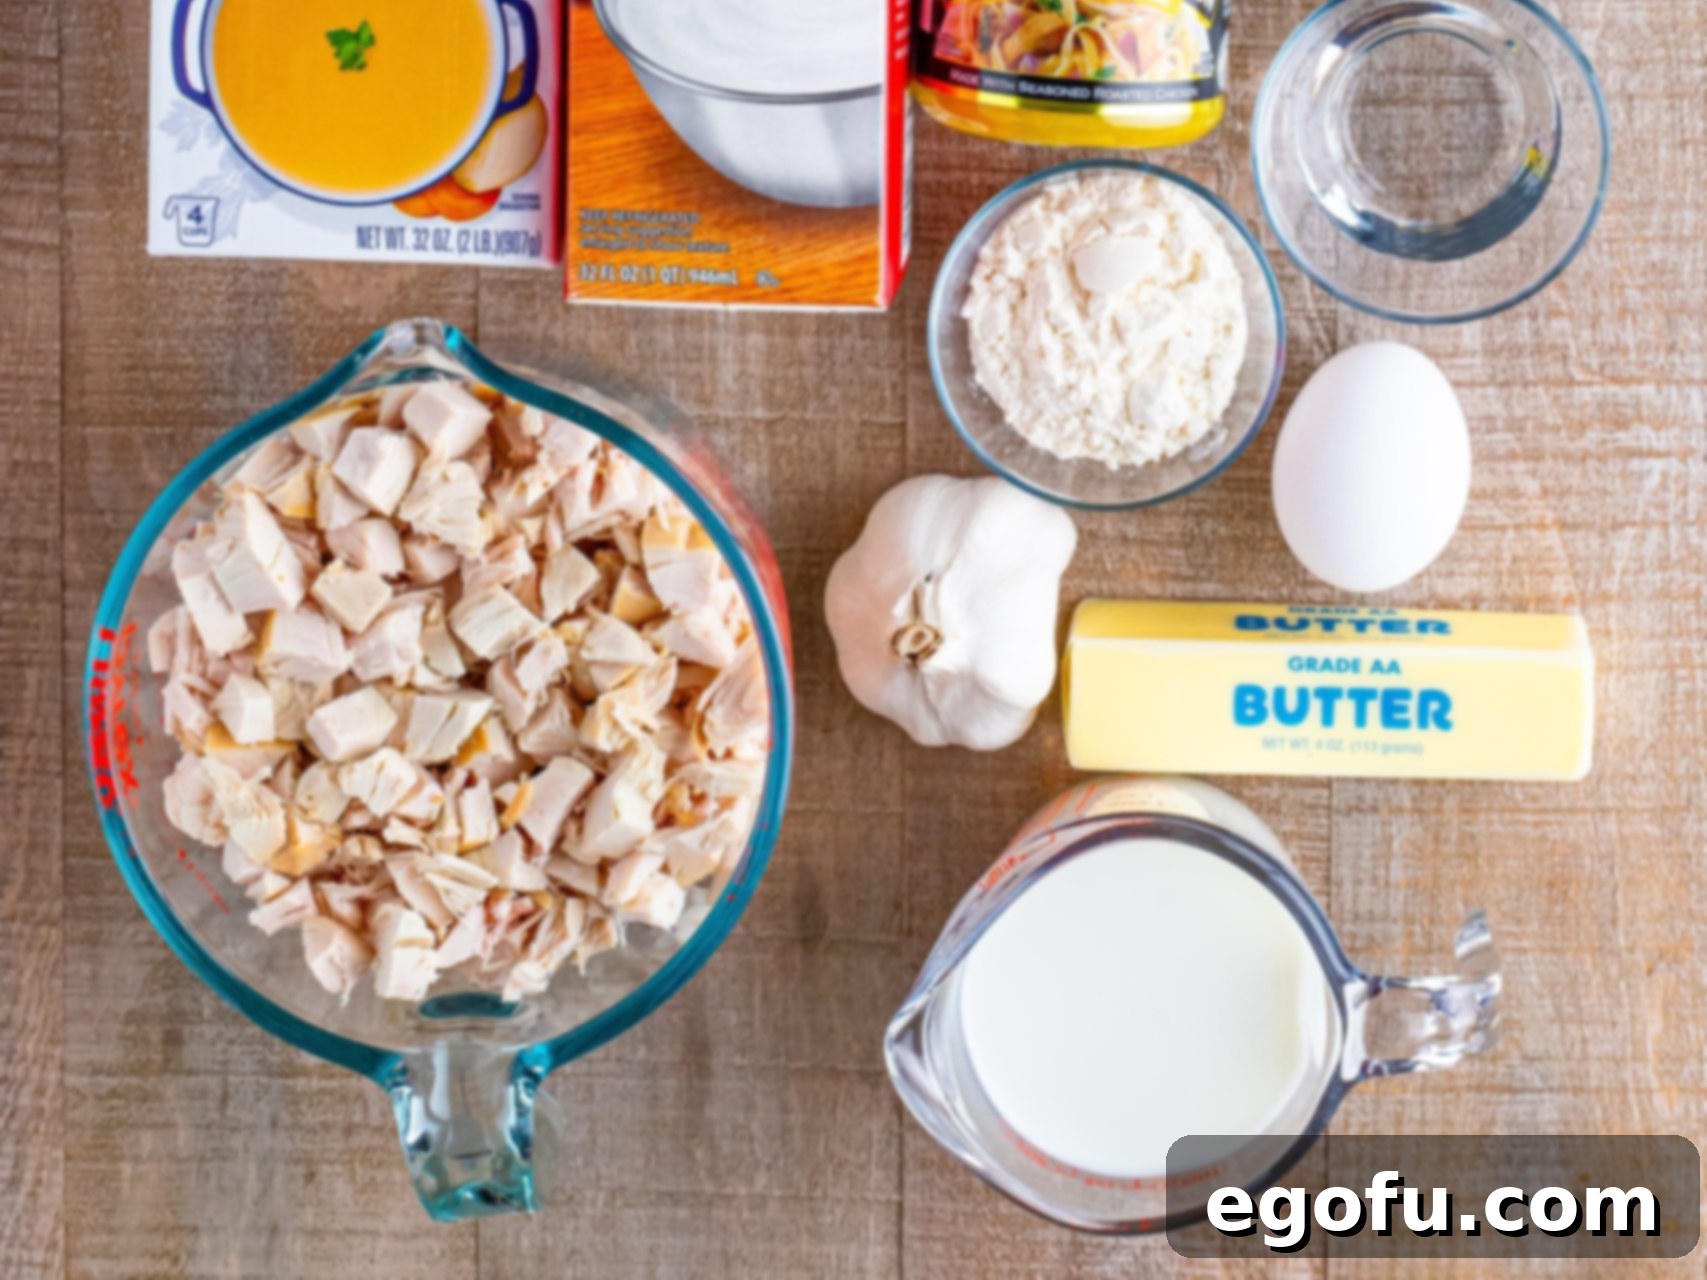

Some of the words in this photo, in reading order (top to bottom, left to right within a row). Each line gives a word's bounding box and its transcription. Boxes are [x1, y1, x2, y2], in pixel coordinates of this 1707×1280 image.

[1018, 79, 1091, 100] SEASONED
[187, 204, 205, 225] 4
[356, 225, 381, 250] NET
[384, 226, 410, 250] WT.
[412, 227, 430, 252] 32
[432, 228, 454, 252] OZ.
[600, 263, 616, 282] FL
[620, 264, 639, 283] OZ
[1233, 614, 1453, 636] BUTTER
[1287, 655, 1362, 675] GRADE
[1368, 657, 1402, 675] AA
[1232, 682, 1454, 733] BUTTER
[1262, 737, 1285, 751] NET
[1315, 738, 1324, 751] 4
[1380, 741, 1424, 757] grams)
